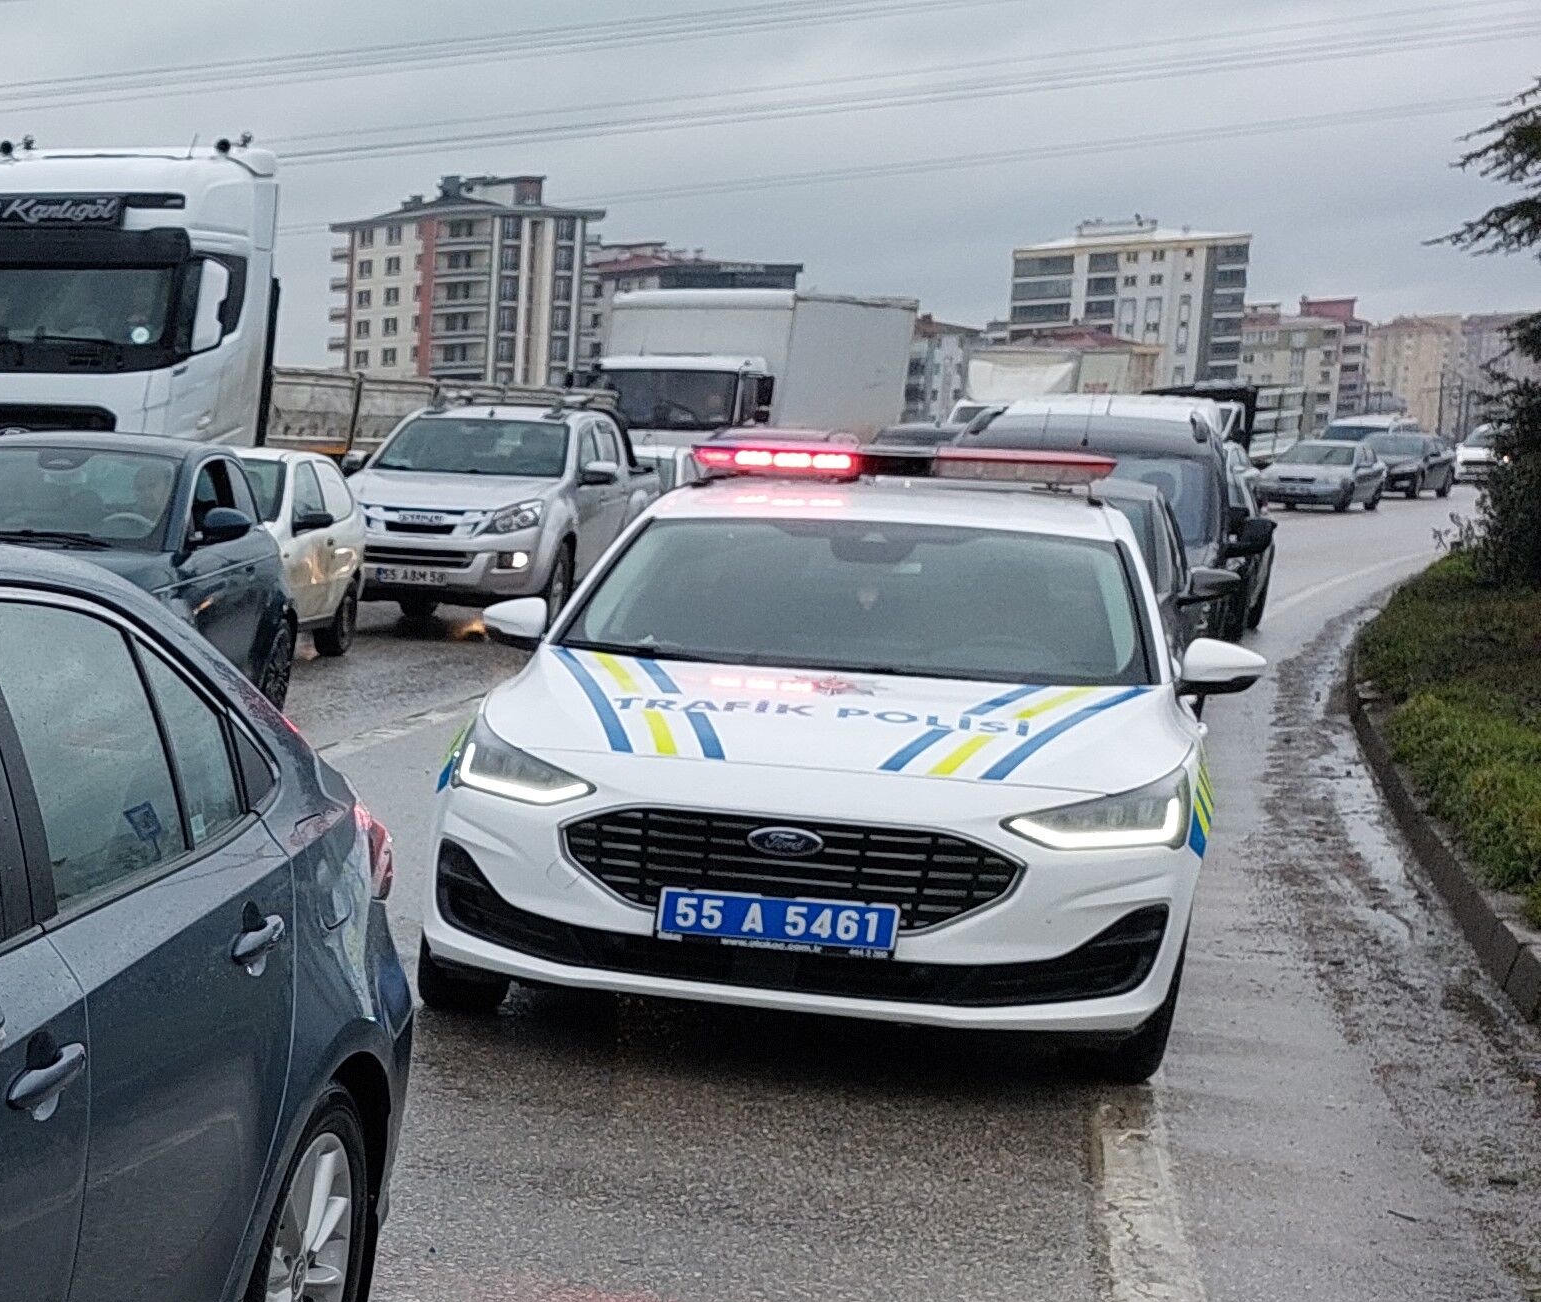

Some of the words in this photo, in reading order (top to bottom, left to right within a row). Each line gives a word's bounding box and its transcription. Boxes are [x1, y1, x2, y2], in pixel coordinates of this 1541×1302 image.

[614, 696, 813, 717] TRAFİK
[836, 707, 1030, 736] POLİSİ
[675, 897, 724, 930] 55
[741, 902, 764, 933] A
[784, 905, 879, 942] 5461
